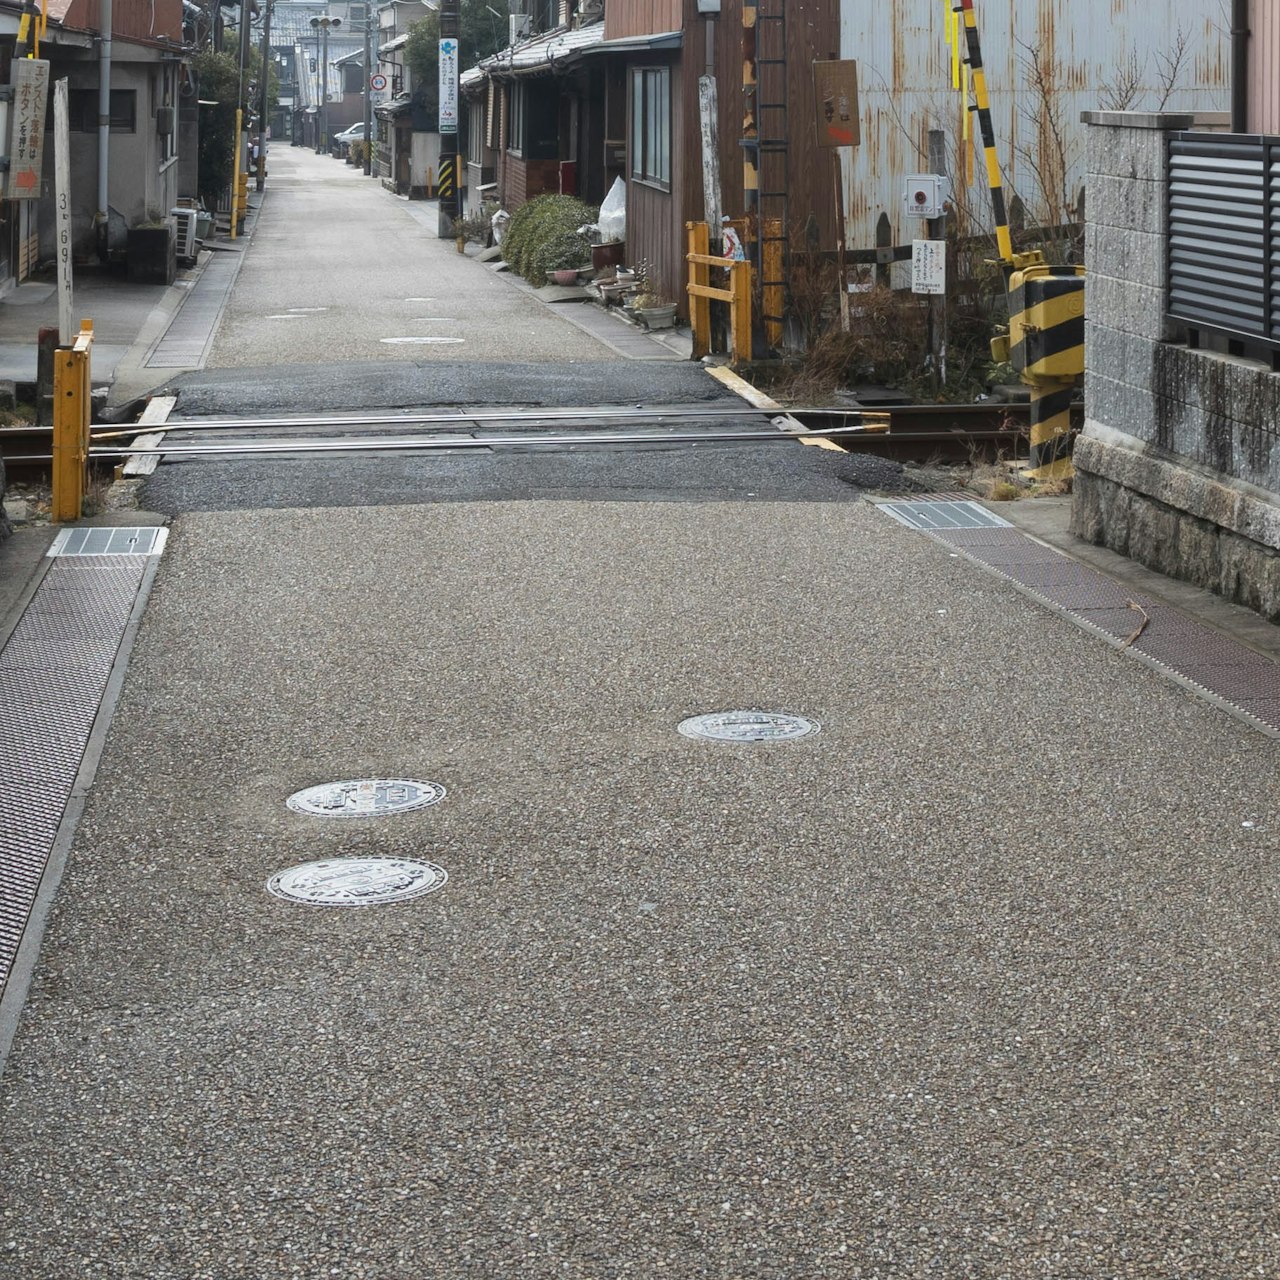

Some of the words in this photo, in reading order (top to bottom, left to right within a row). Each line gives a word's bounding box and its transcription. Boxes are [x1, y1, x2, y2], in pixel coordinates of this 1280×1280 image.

[17, 82, 33, 160] ボタンを押す
[28, 65, 45, 160] エンスト・落輪は
